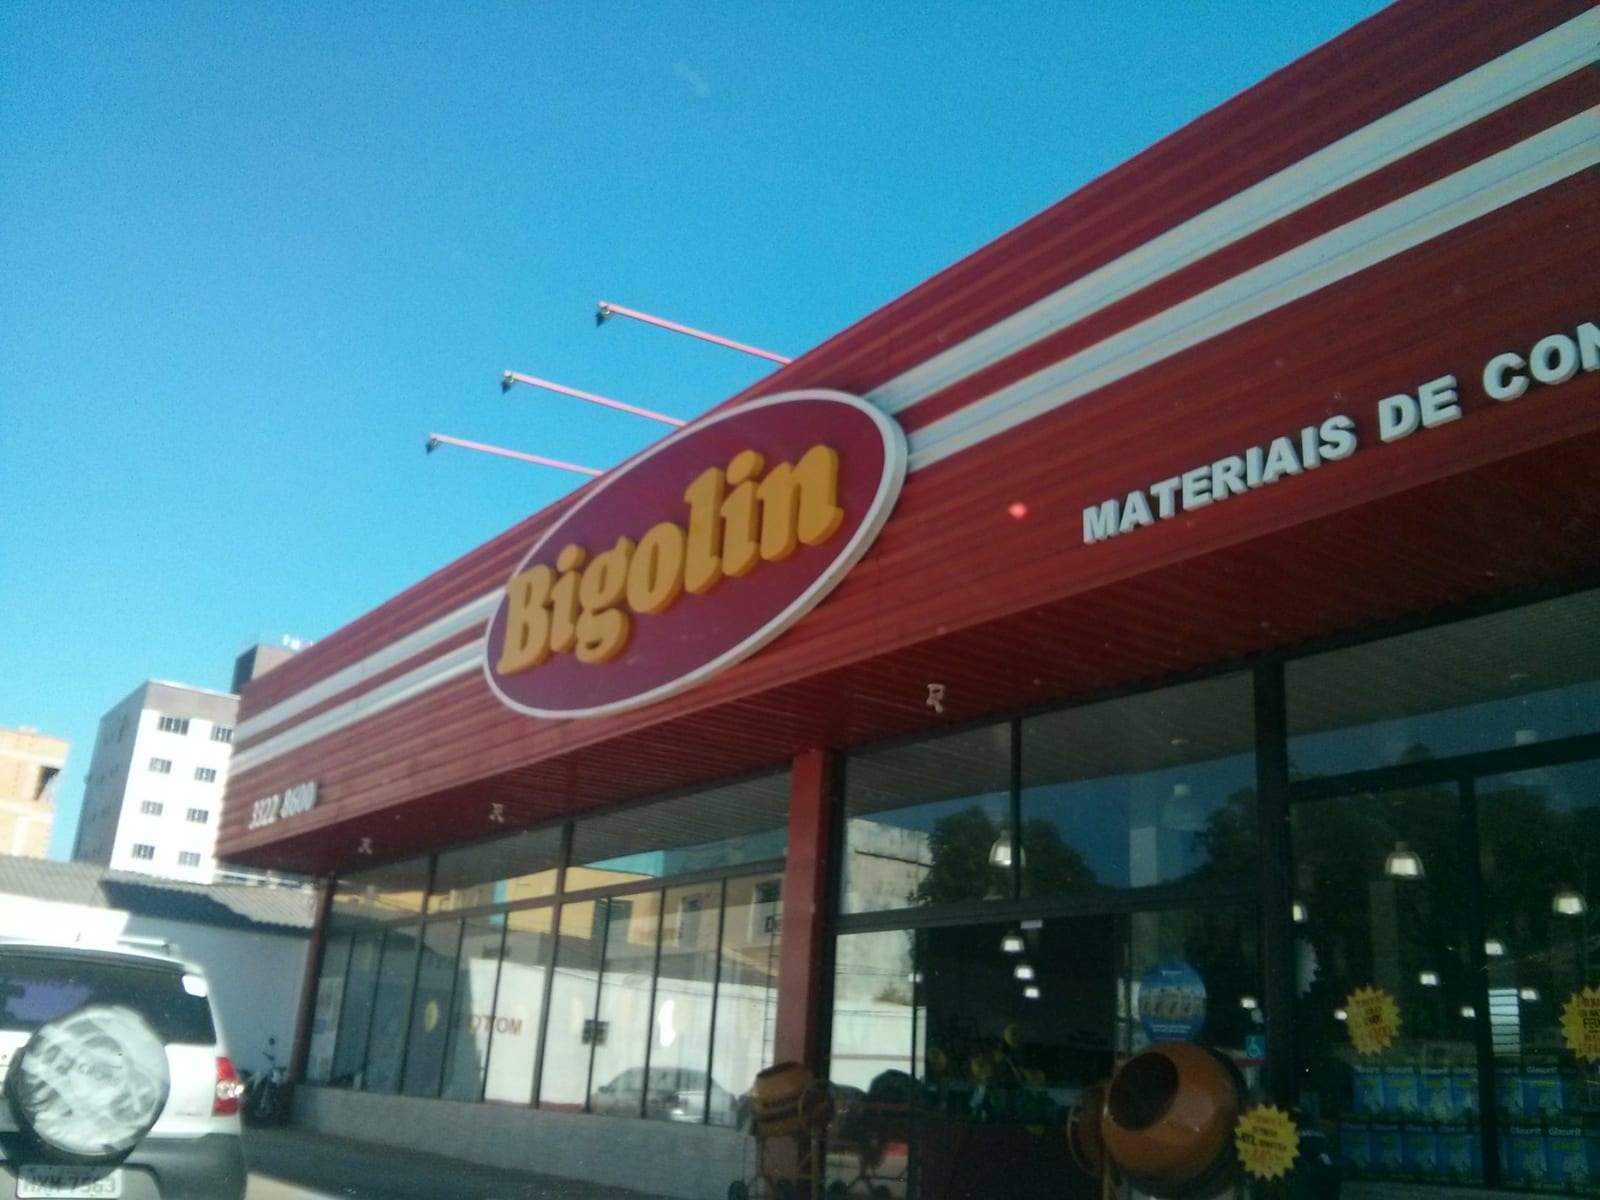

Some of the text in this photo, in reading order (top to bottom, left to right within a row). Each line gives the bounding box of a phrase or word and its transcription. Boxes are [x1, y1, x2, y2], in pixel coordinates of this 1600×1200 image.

[1083, 415, 1358, 545] MATERIAIS
[1378, 374, 1462, 442] DE
[497, 445, 844, 675] Bigolin
